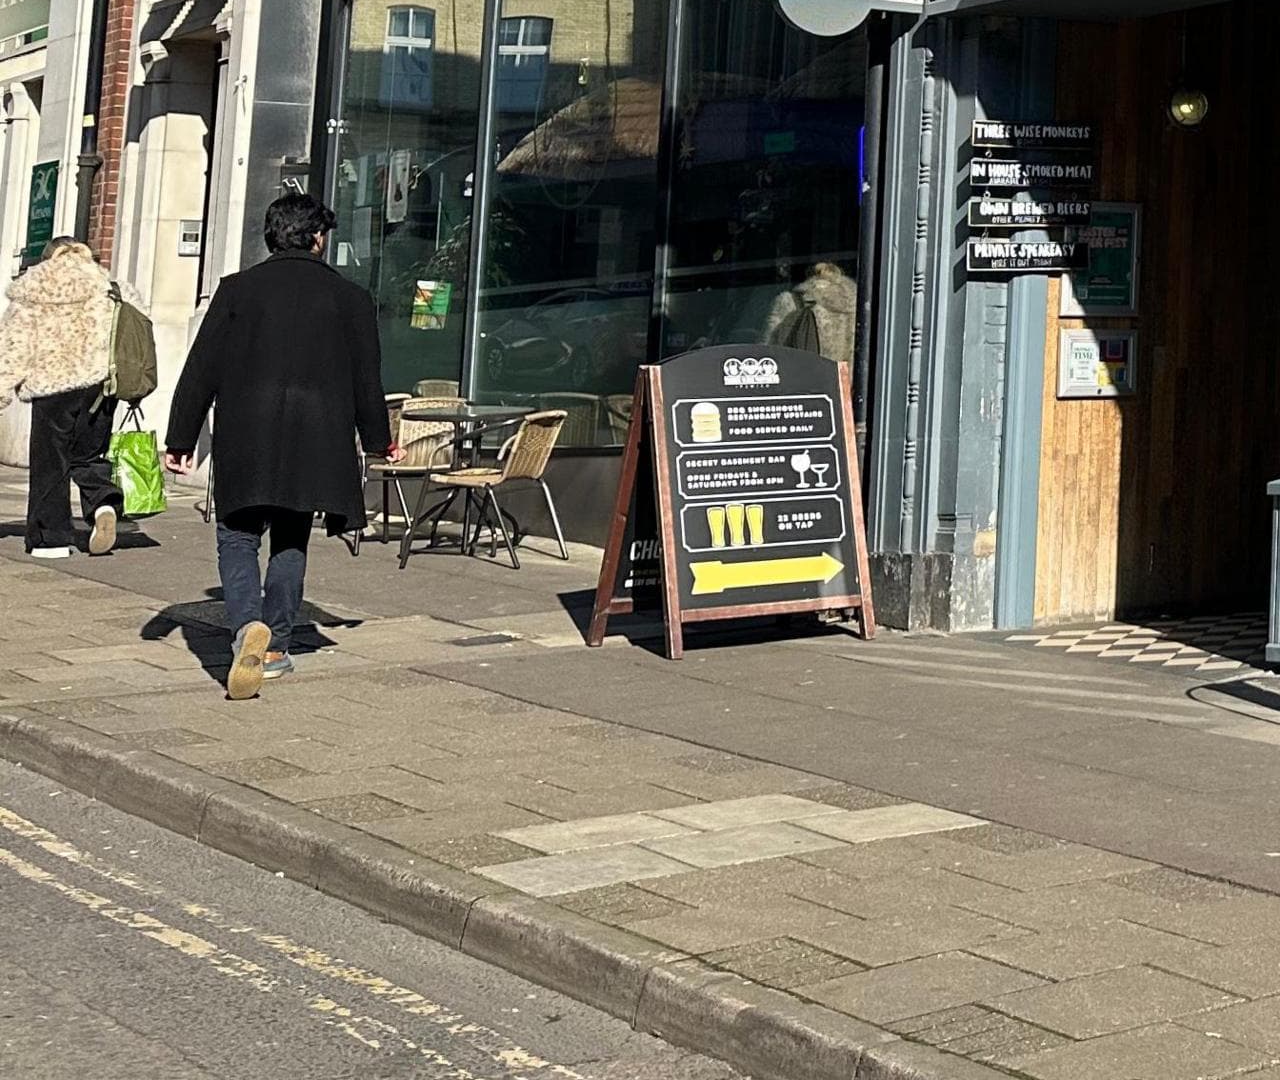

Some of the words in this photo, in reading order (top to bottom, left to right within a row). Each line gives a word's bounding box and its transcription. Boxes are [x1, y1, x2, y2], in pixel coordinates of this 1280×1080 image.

[974, 123, 1012, 139] THREE
[1013, 125, 1041, 138] WISE
[1042, 125, 1091, 139] MONKEYS
[972, 163, 986, 177] IN
[988, 163, 1022, 178] HOUSE
[1022, 164, 1064, 179] SMOKED
[1065, 164, 1093, 179] MEAT
[979, 201, 1010, 216] OWN
[1011, 201, 1055, 217] BREWED
[1056, 202, 1090, 216] BEERS
[974, 242, 1018, 259] PRIVATE
[1018, 241, 1076, 259] SPEAKEASY
[747, 404, 803, 414] SMOKEHOUSE
[727, 412, 782, 421] RESTAURANT
[783, 410, 823, 419] UPSTAIRS
[729, 427, 753, 435] FOOD
[755, 426, 788, 434] SERVED
[789, 424, 814, 433] DAILY
[685, 459, 718, 468] SECRET
[720, 456, 766, 466] BASEMENT
[767, 455, 786, 464] BAR
[687, 474, 711, 482] OPEN
[713, 471, 750, 480] FRIDAYS
[687, 480, 738, 489] SATURDAYS
[739, 478, 764, 487] FROM
[791, 512, 822, 522] BEERS
[778, 522, 793, 531] ON
[795, 520, 814, 529] TAP
